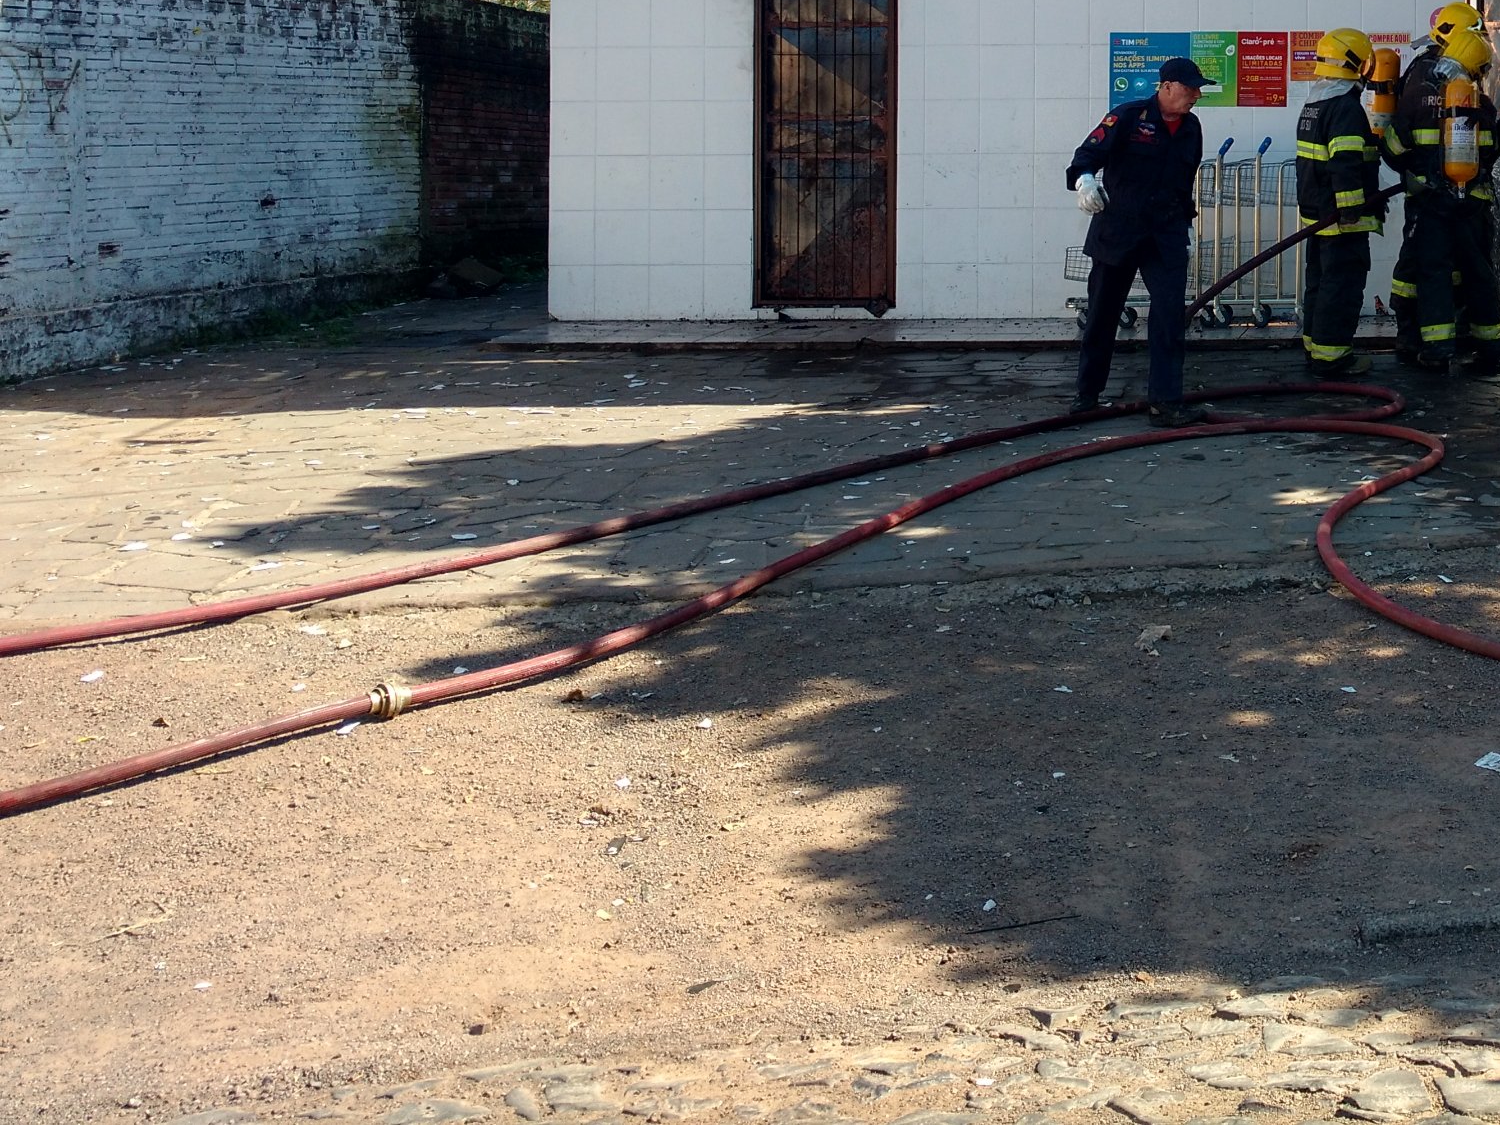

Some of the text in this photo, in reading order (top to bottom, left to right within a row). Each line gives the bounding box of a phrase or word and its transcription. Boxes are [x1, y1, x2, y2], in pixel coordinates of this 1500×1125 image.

[1135, 38, 1149, 46] PRÉ
[1394, 34, 1409, 43] AQUI
[1113, 55, 1145, 63] LIGAÇÕES
